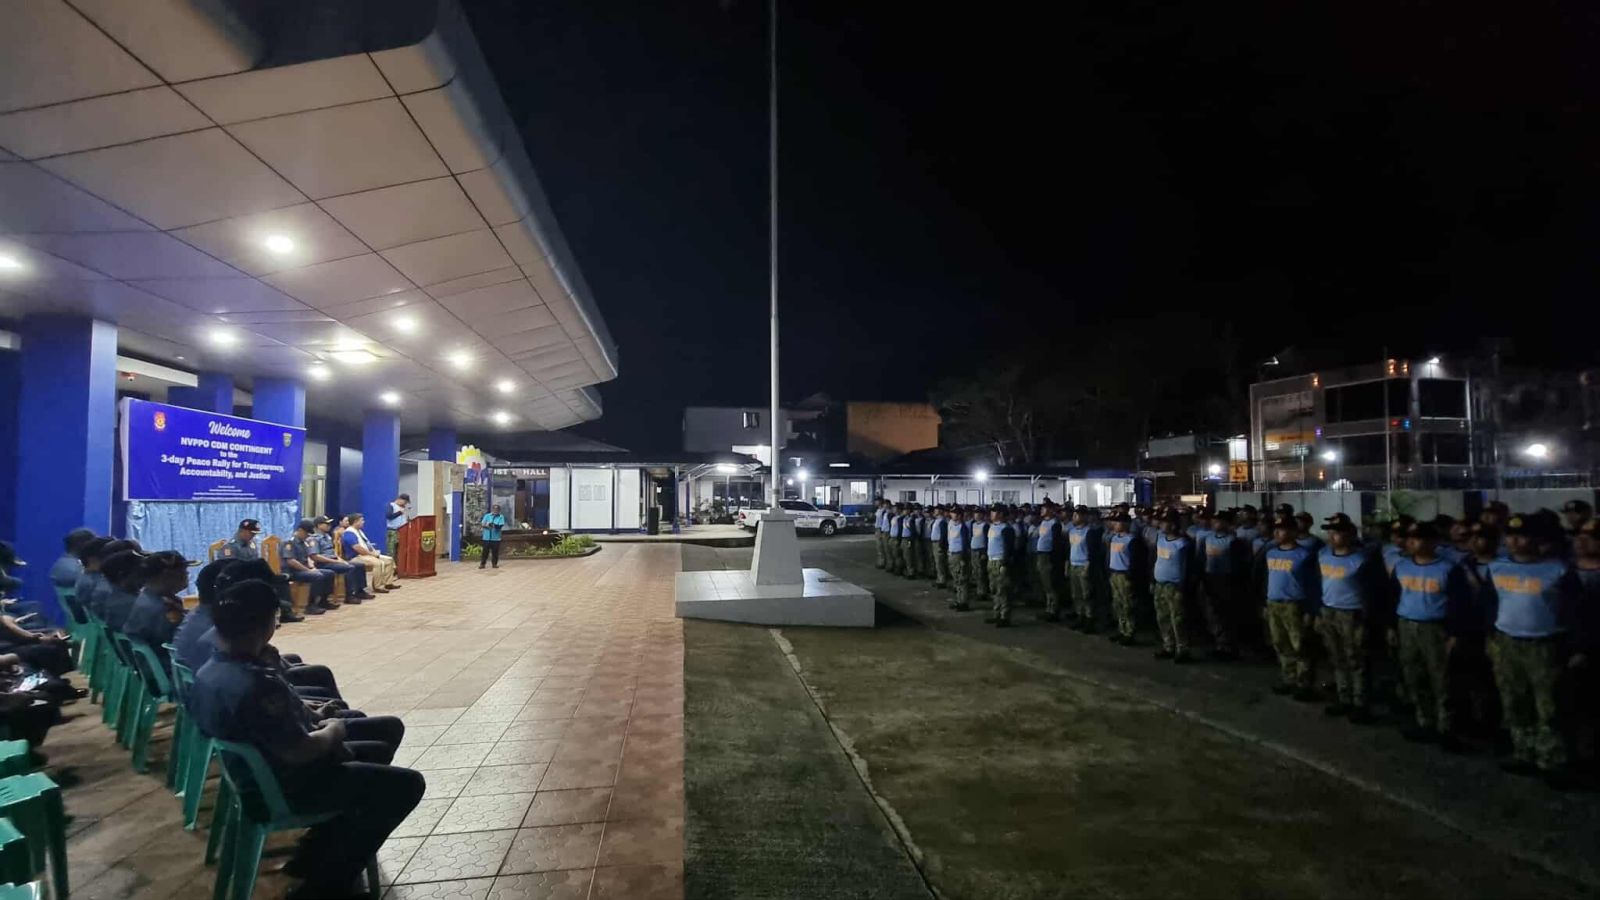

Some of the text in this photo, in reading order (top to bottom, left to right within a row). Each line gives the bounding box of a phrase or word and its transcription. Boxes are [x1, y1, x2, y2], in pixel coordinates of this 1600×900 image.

[208, 421, 251, 439] Welcome
[181, 437, 273, 455] NVPPO CDM CONTINGENT
[228, 451, 238, 459] the
[161, 454, 285, 473] 3-day Peace Rally for Transparency,
[235, 471, 248, 479] and
[248, 472, 271, 480] Justice
[523, 468, 547, 476] HALL
